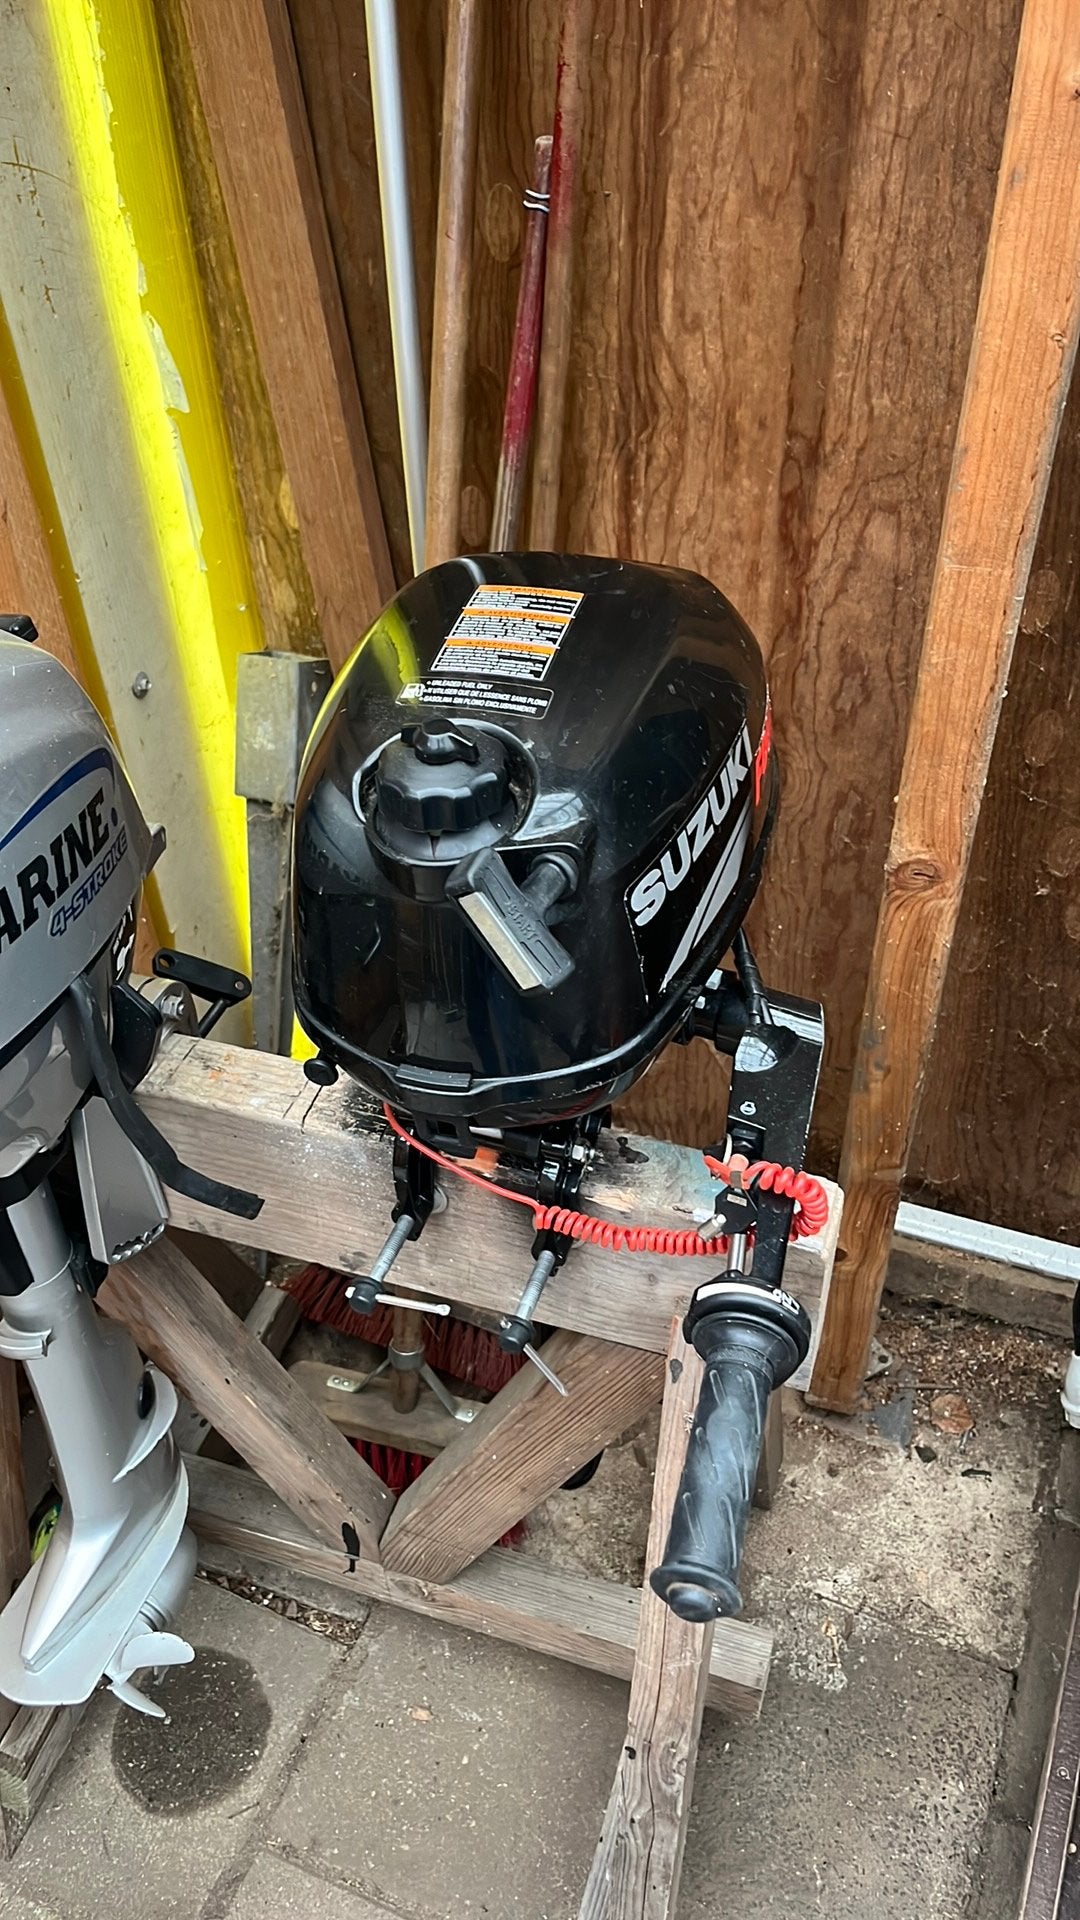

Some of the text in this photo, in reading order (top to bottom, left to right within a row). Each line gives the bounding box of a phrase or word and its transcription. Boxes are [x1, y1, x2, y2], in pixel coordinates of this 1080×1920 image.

[461, 681, 477, 689] FUEL
[476, 682, 494, 690] ONLY
[630, 725, 753, 926] SUZUKI
[50, 821, 129, 937] 4-STROKE
[505, 901, 540, 941] START
